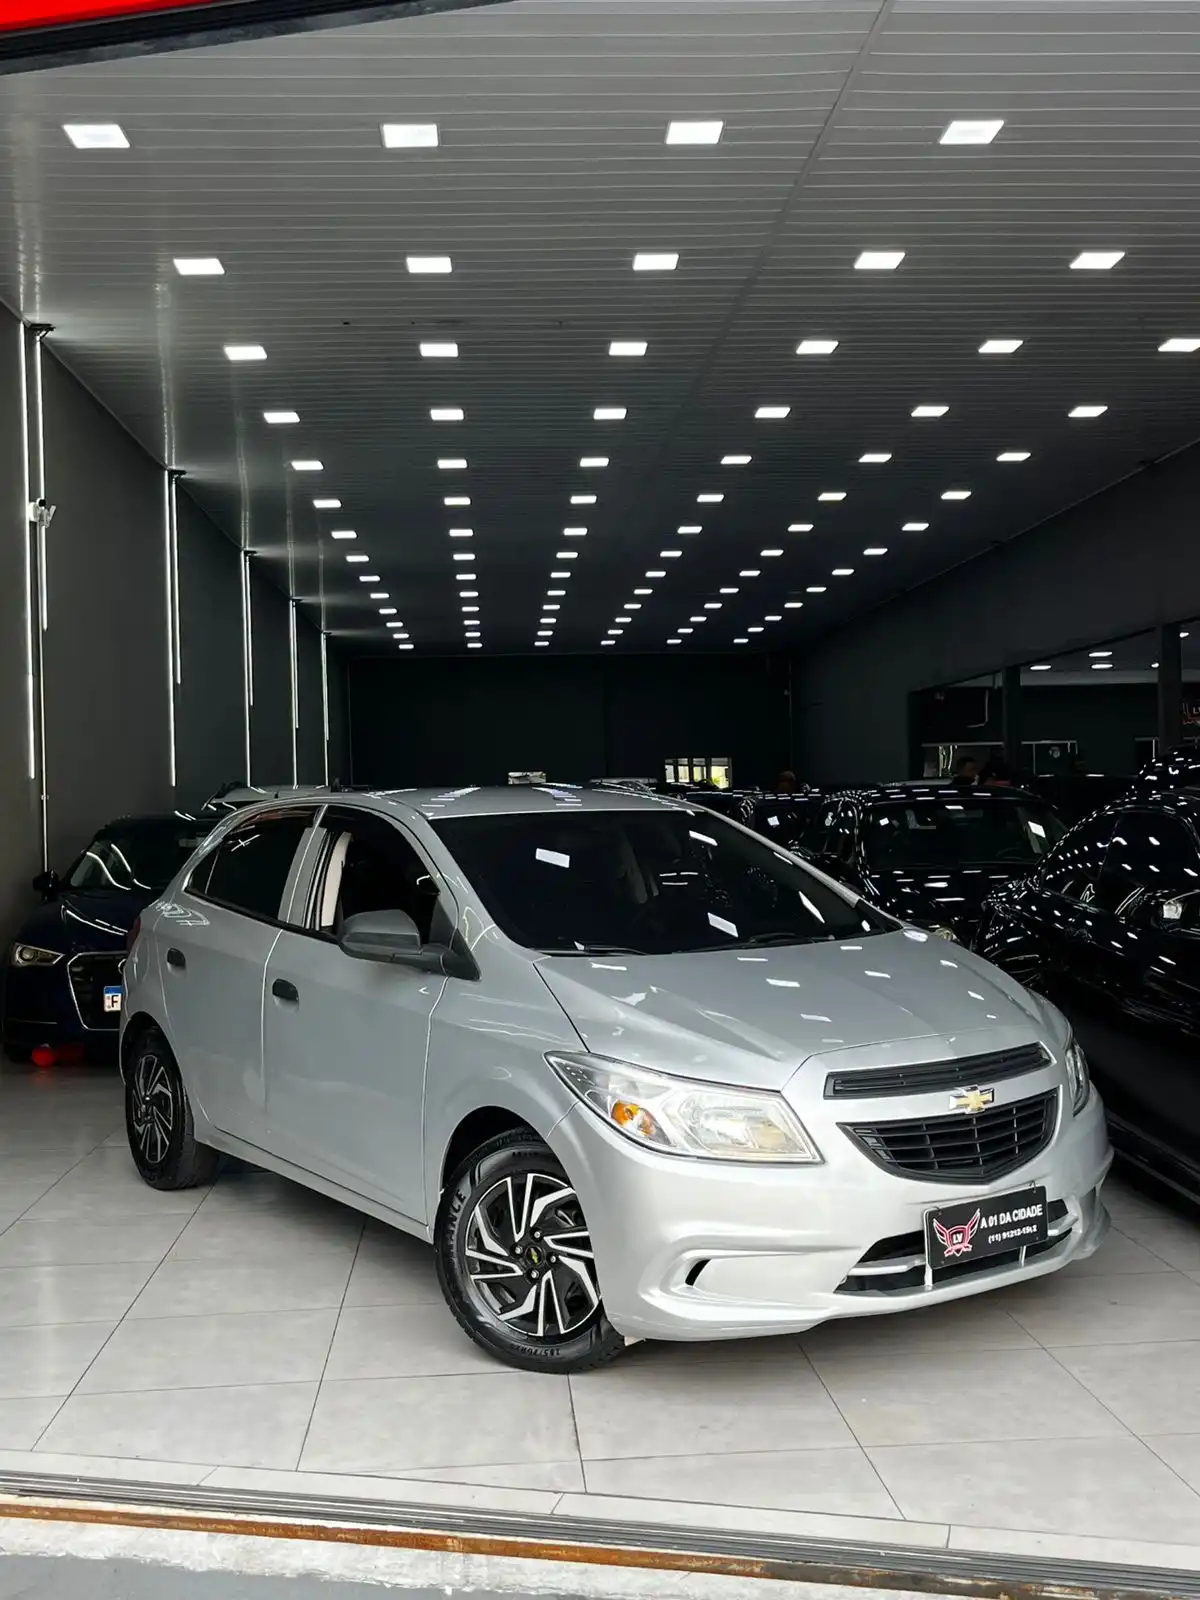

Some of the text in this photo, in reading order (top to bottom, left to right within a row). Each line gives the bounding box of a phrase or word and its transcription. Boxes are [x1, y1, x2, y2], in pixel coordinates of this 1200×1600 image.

[980, 1204, 1043, 1229] A 01 DA CIDADE
[952, 1233, 963, 1244] LV
